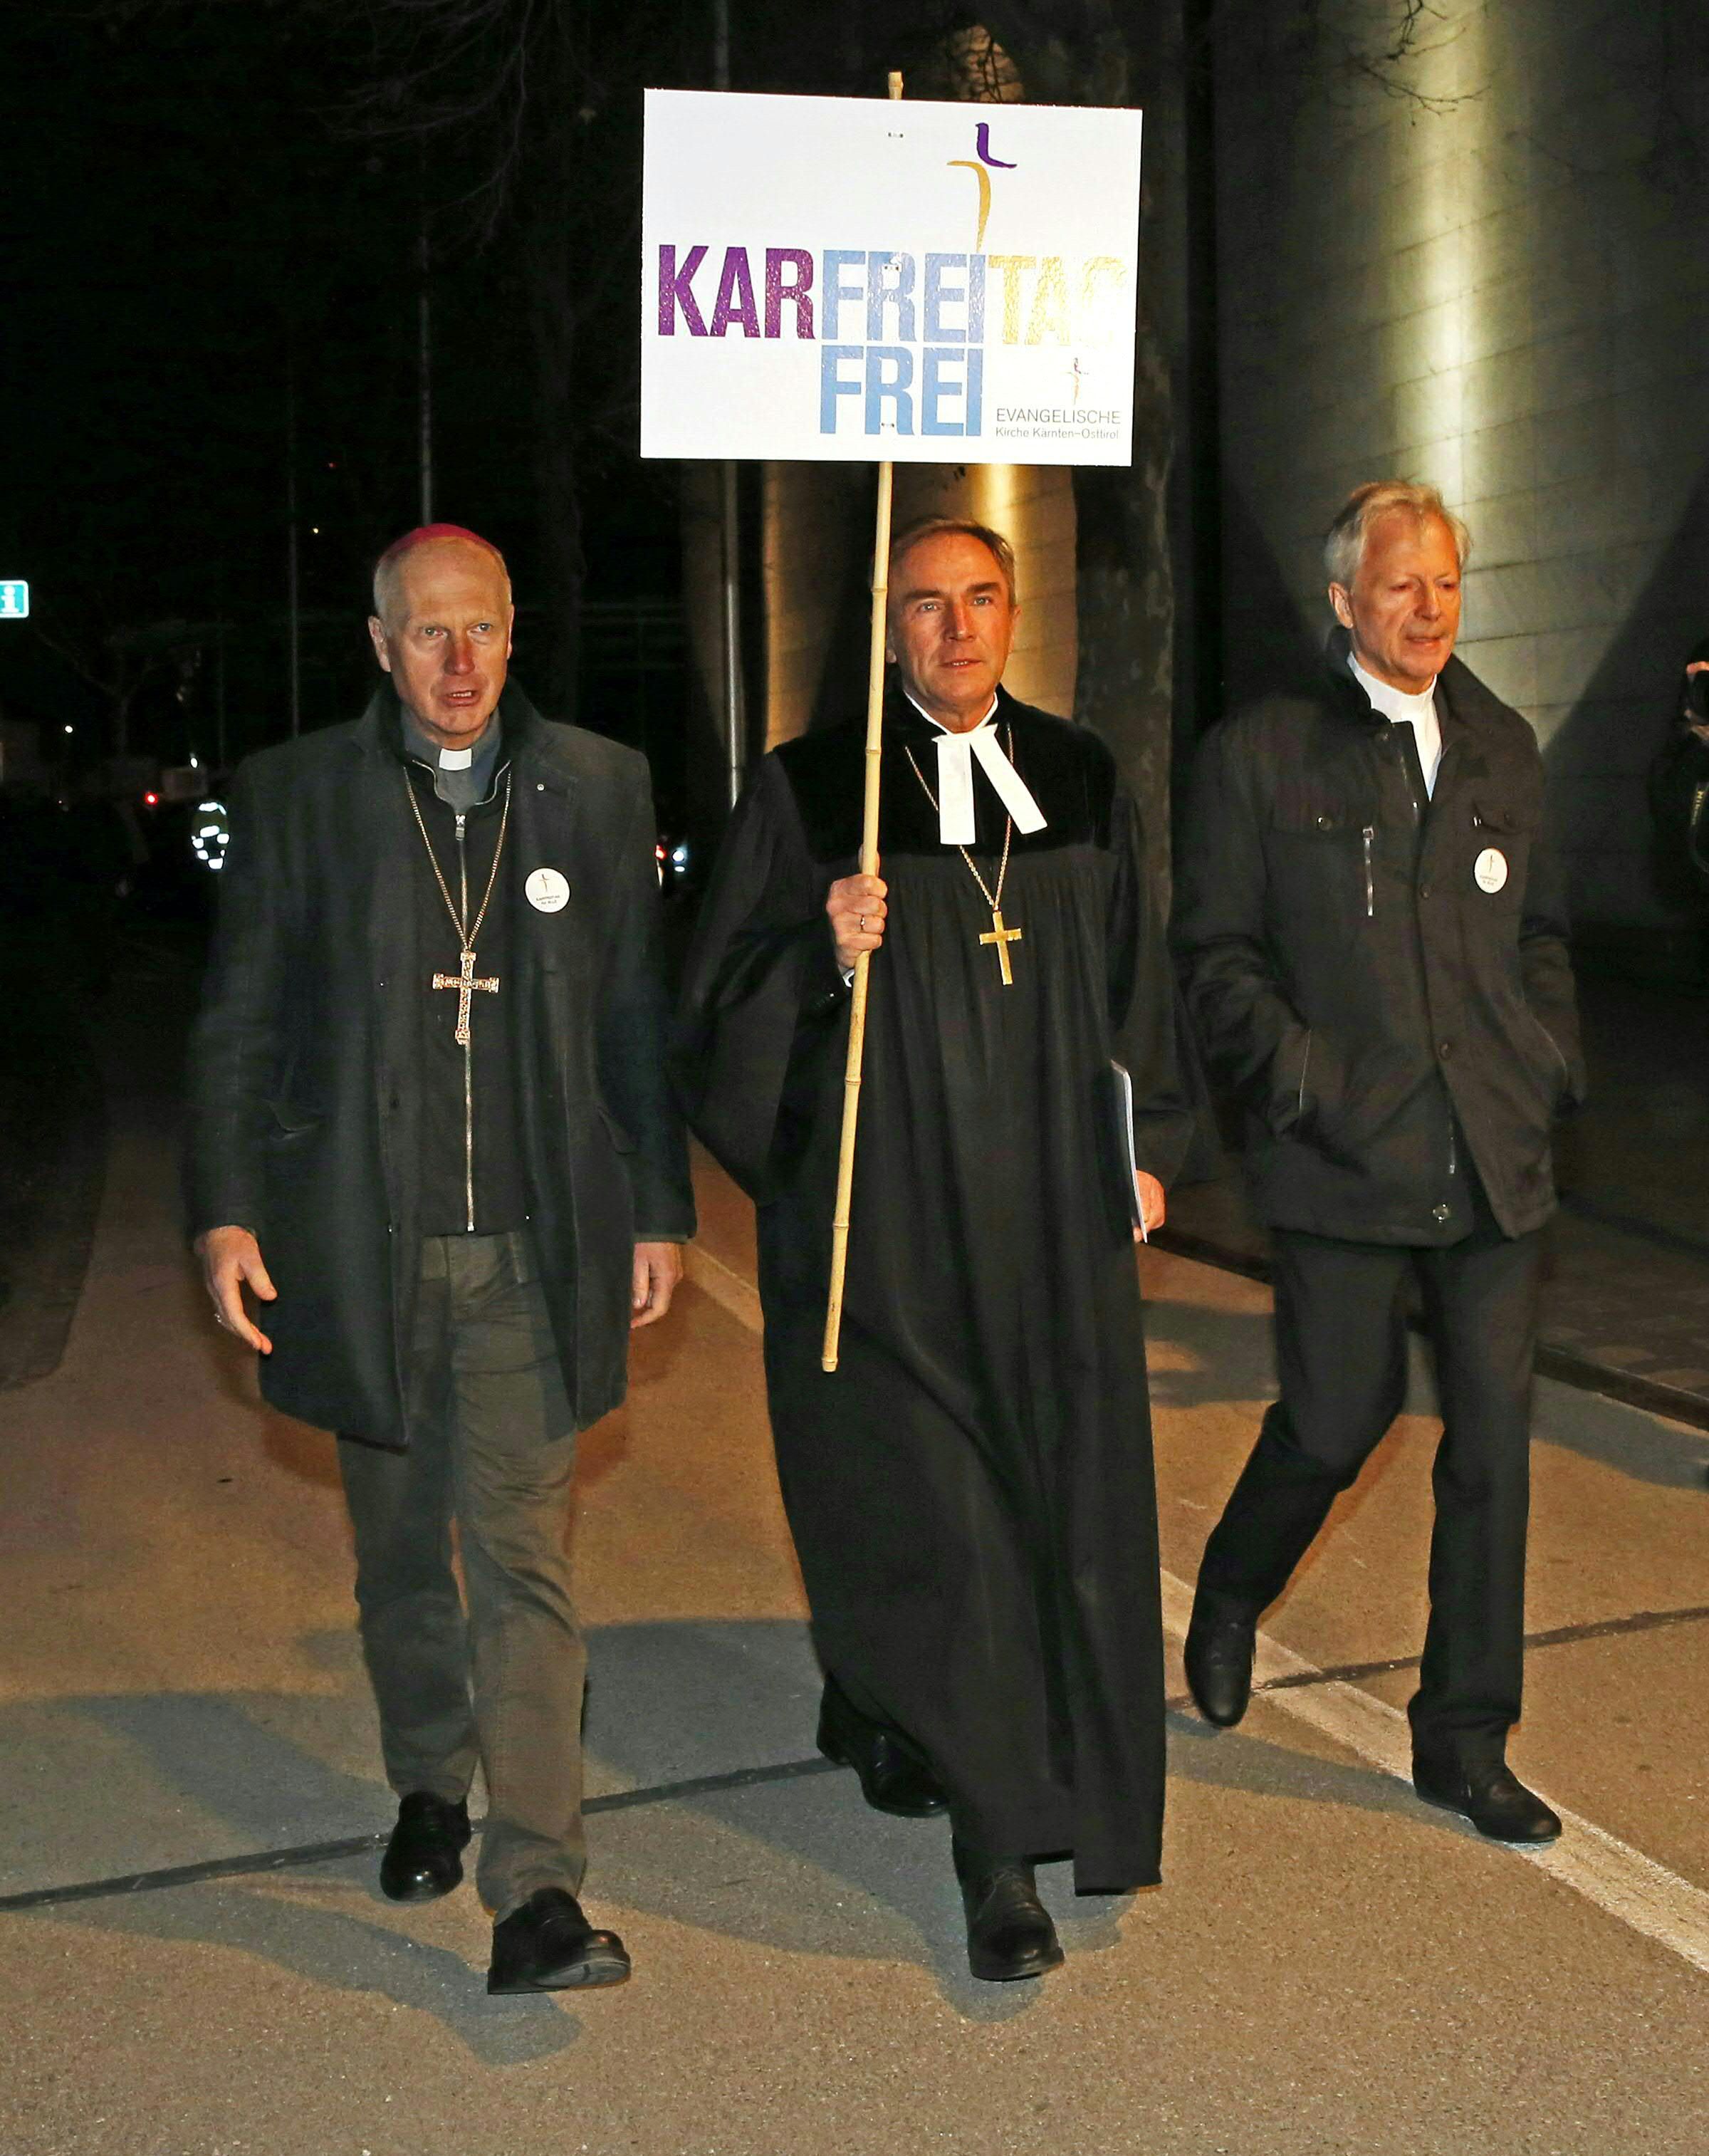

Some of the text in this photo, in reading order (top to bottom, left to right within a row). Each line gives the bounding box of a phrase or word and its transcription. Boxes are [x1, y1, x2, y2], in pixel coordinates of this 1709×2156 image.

[820, 345, 983, 437] FREI
[996, 407, 1122, 425] EVANGELISCHE
[995, 427, 1030, 437] Kirche
